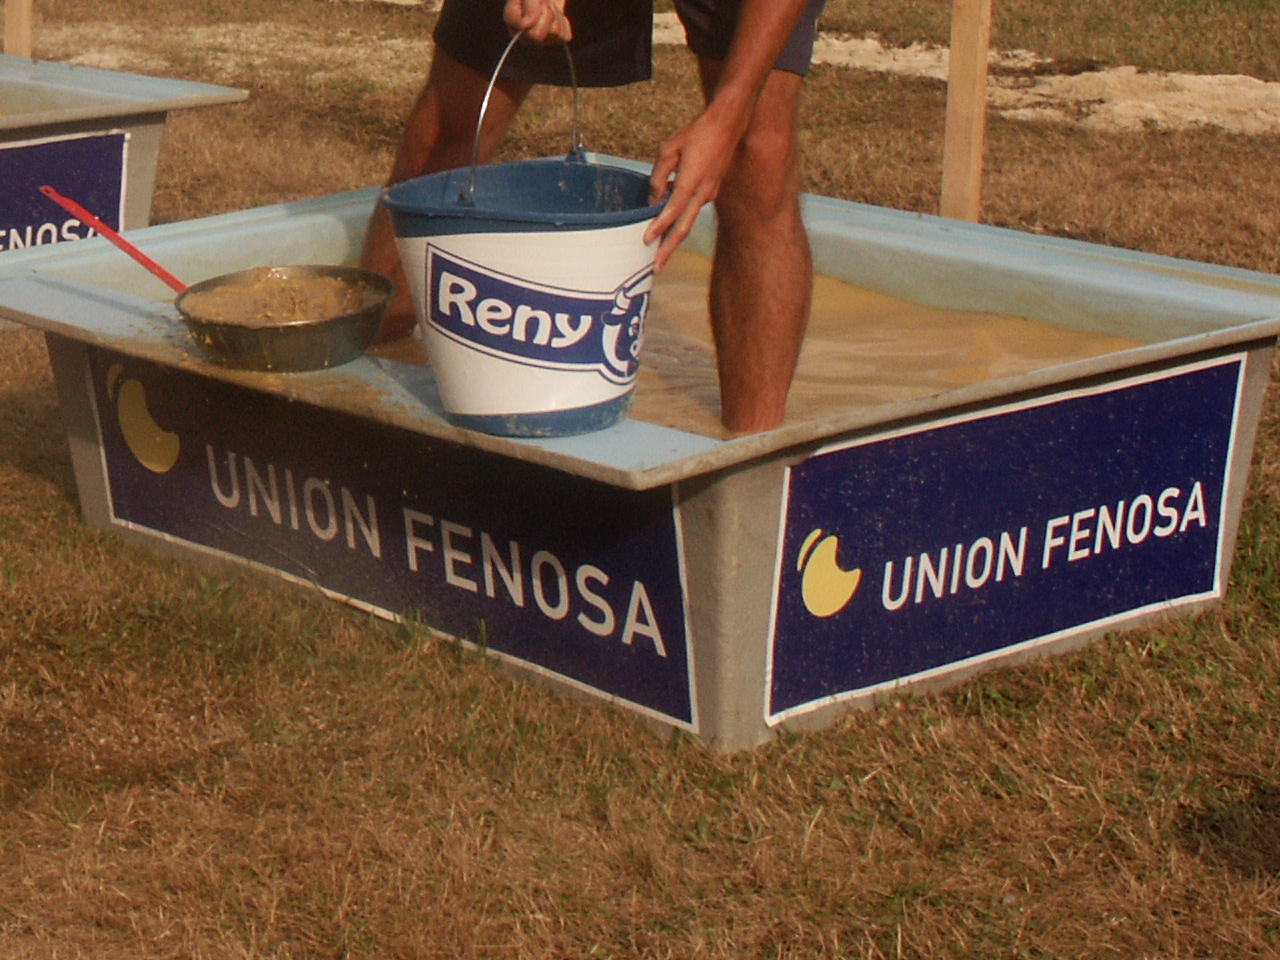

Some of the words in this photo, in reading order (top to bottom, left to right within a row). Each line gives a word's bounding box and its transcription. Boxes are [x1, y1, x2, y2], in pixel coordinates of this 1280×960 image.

[439, 271, 593, 349] Reny
[206, 444, 382, 560] UNION
[403, 507, 668, 658] FENOSA
[882, 527, 1029, 611] UNION
[1042, 481, 1207, 569] FENOSA
